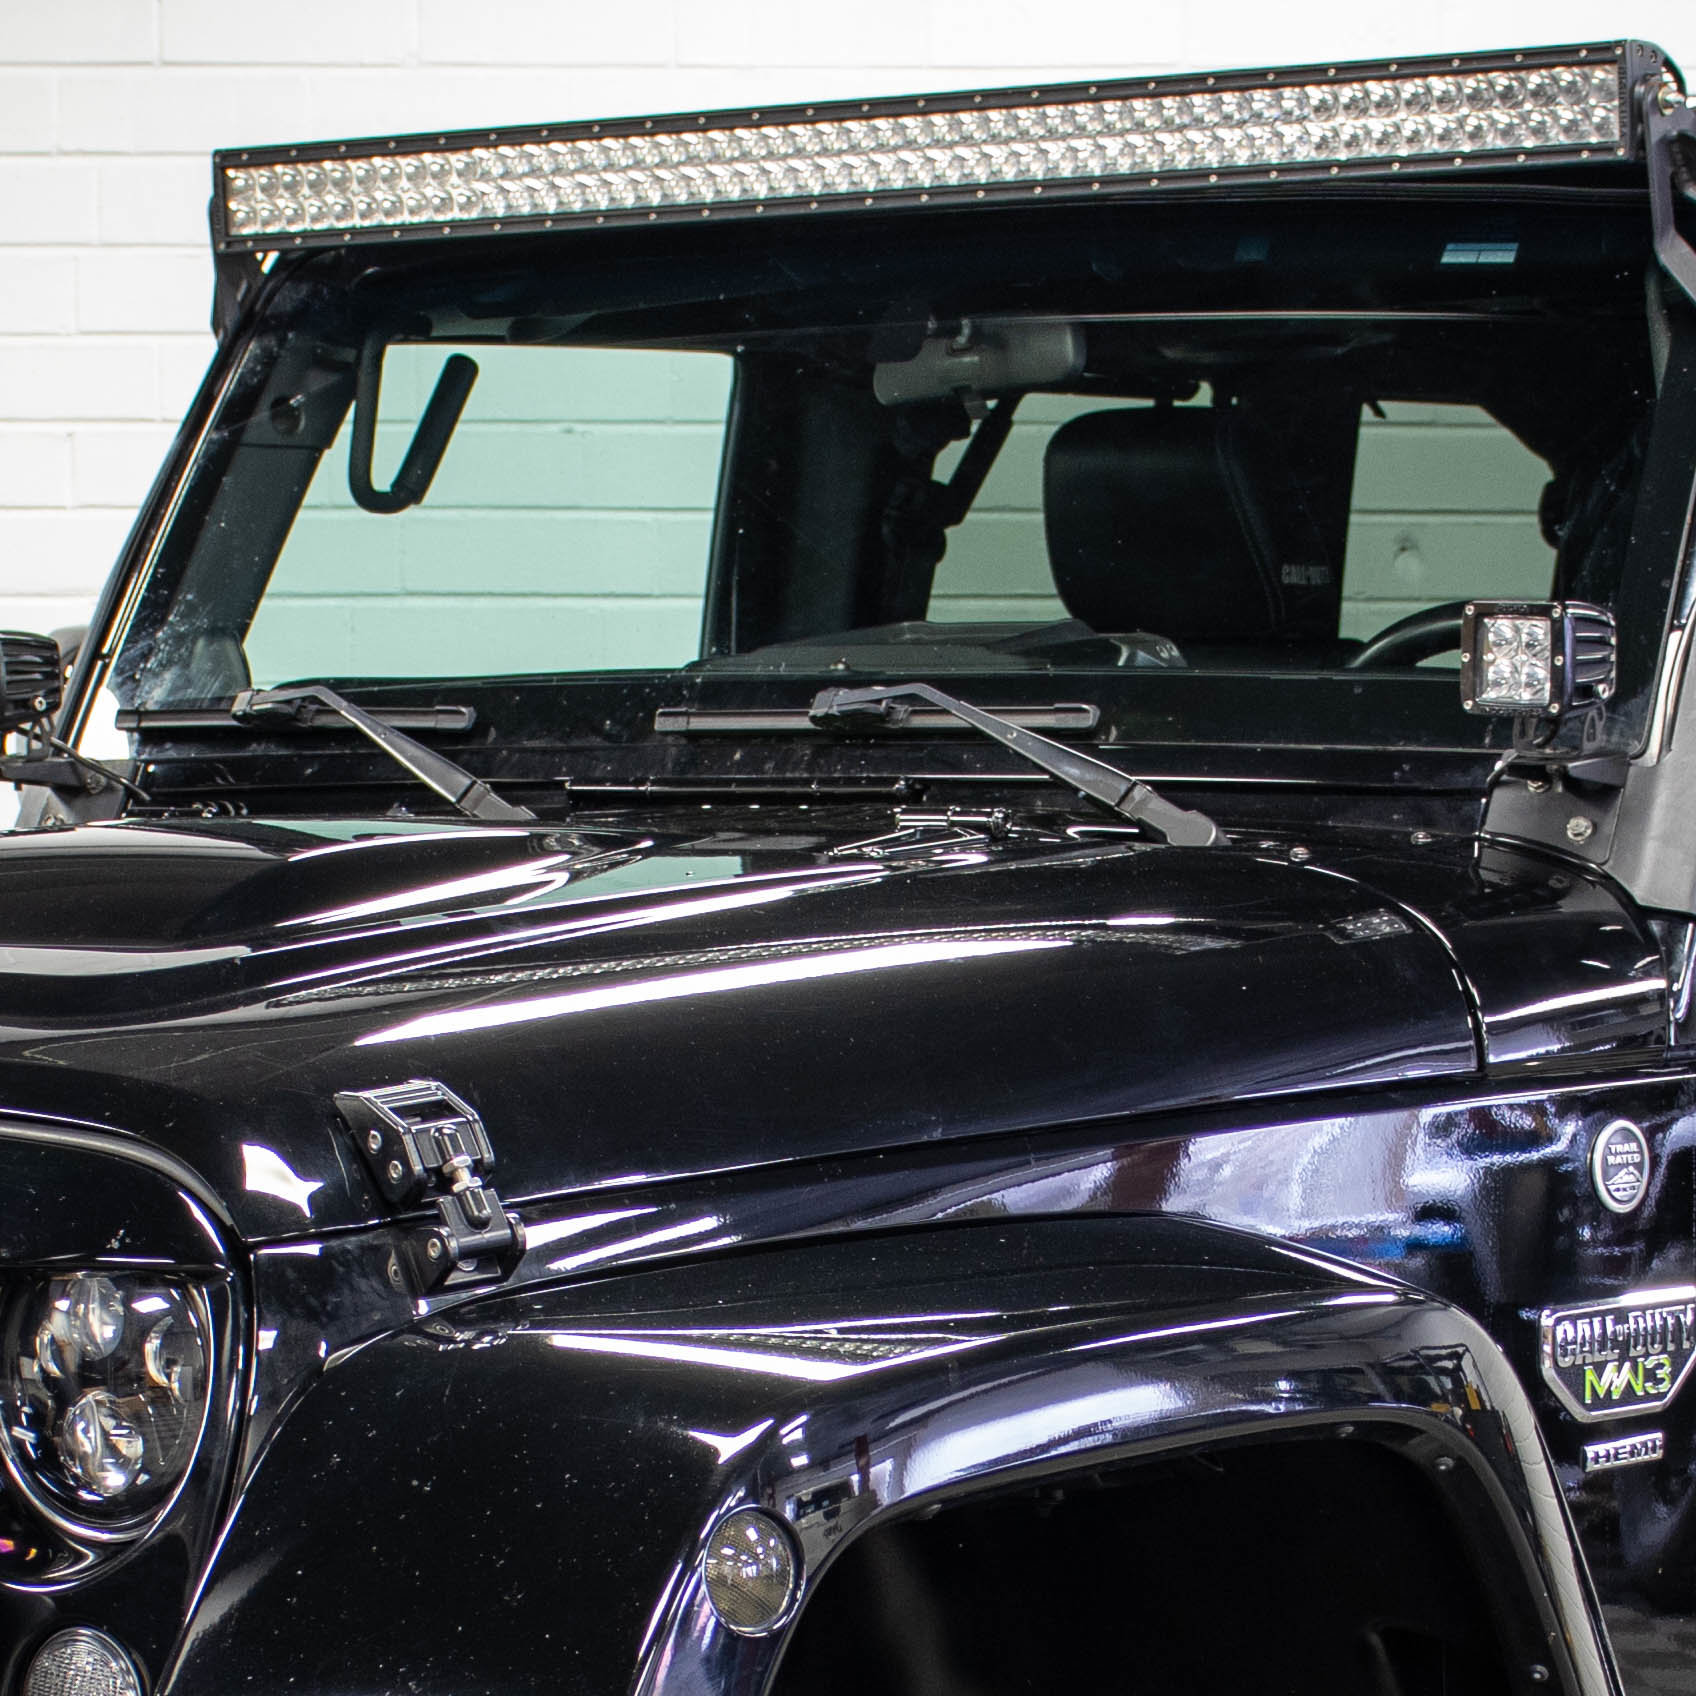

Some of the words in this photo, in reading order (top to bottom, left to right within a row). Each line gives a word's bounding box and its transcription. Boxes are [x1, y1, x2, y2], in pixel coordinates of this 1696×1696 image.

[1607, 1153, 1641, 1165] RATED
[1608, 1142, 1639, 1154] TRAIL
[1556, 1315, 1620, 1367] CALL
[1616, 1324, 1630, 1341] OF
[1628, 1304, 1695, 1357] DUTY
[1584, 1354, 1672, 1404] MW3
[1588, 1437, 1663, 1468] HEMI
